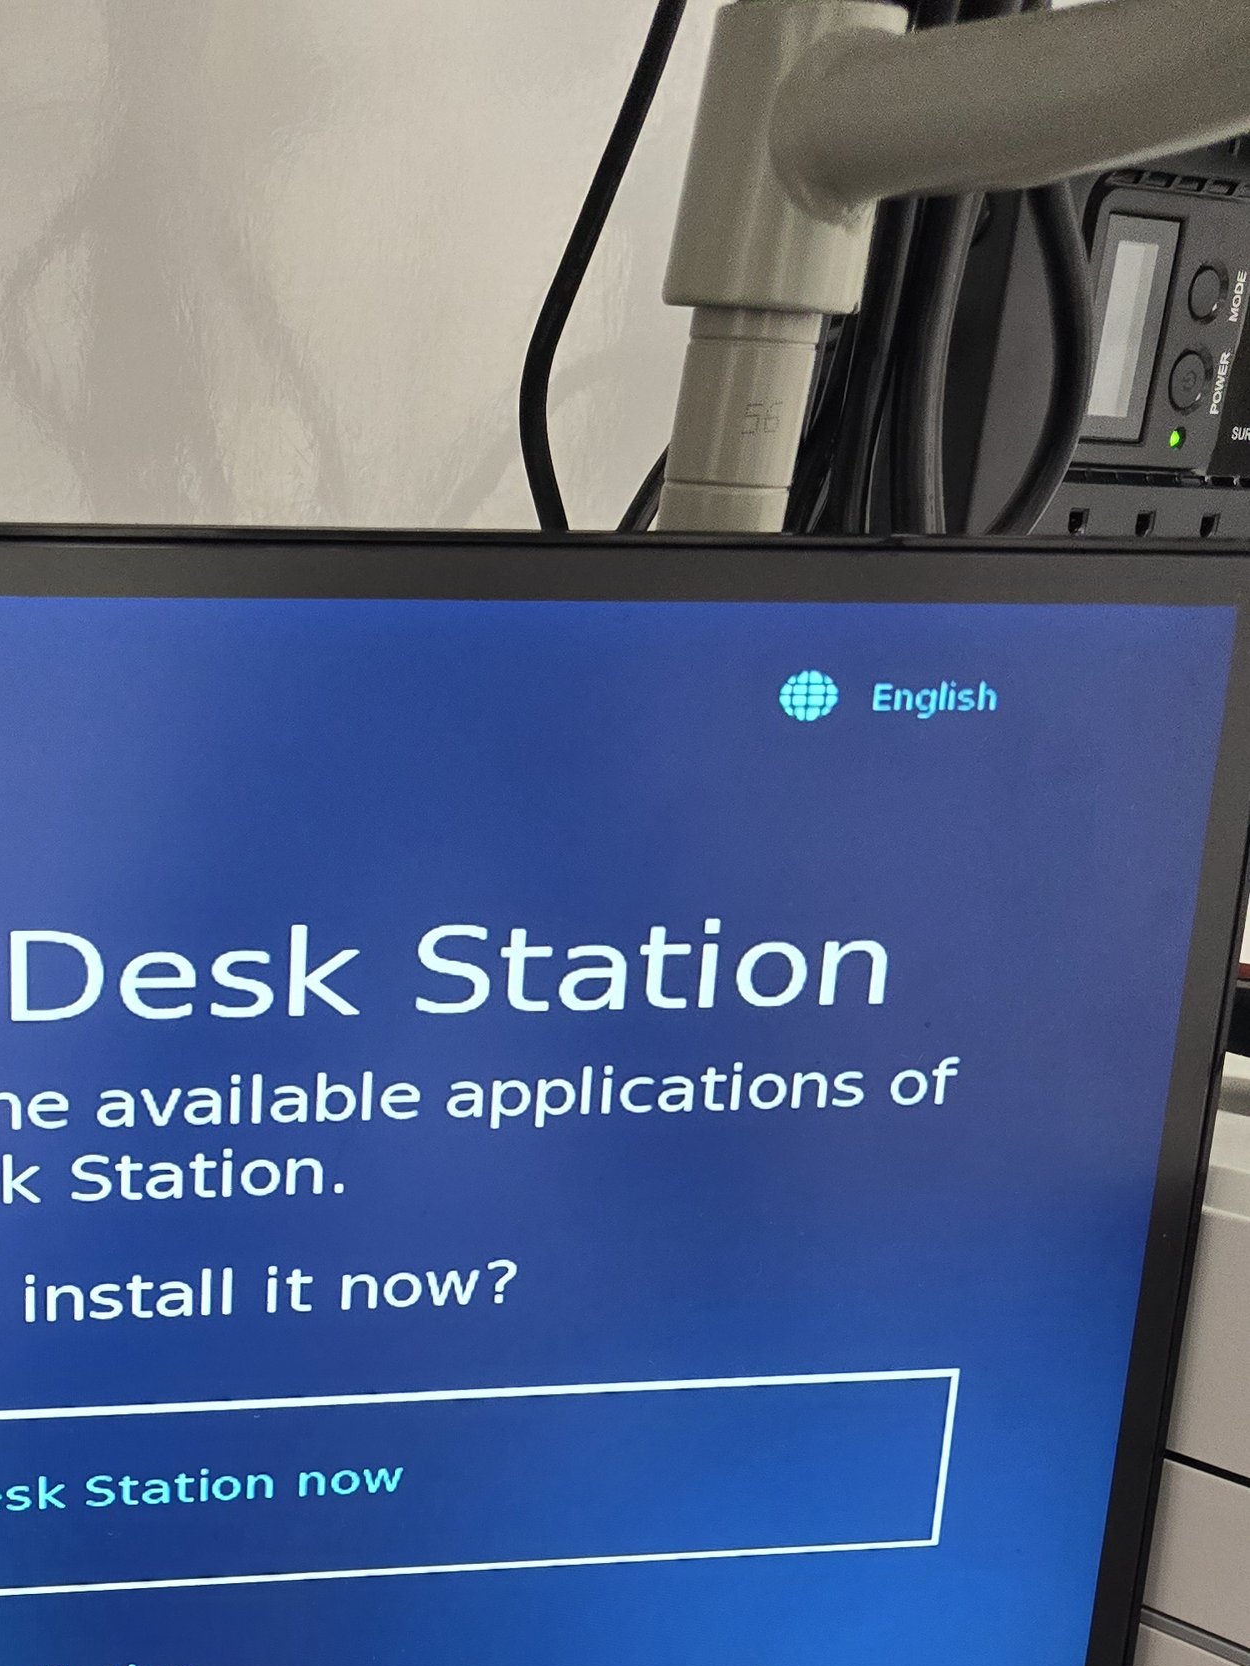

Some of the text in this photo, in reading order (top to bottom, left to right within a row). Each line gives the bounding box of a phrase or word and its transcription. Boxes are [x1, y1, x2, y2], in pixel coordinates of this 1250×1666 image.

[1229, 270, 1247, 322] MODE
[1210, 352, 1231, 415] POWER
[872, 680, 998, 720] English
[415, 917, 889, 1014] Station
[96, 1070, 421, 1128] available
[446, 1061, 865, 1130] applications
[889, 1055, 961, 1106] of
[70, 1147, 345, 1202] Station.
[24, 1266, 234, 1323] install
[266, 1265, 314, 1314] it
[340, 1258, 518, 1311] now?
[85, 1467, 274, 1508] Station
[298, 1466, 404, 1498] now
